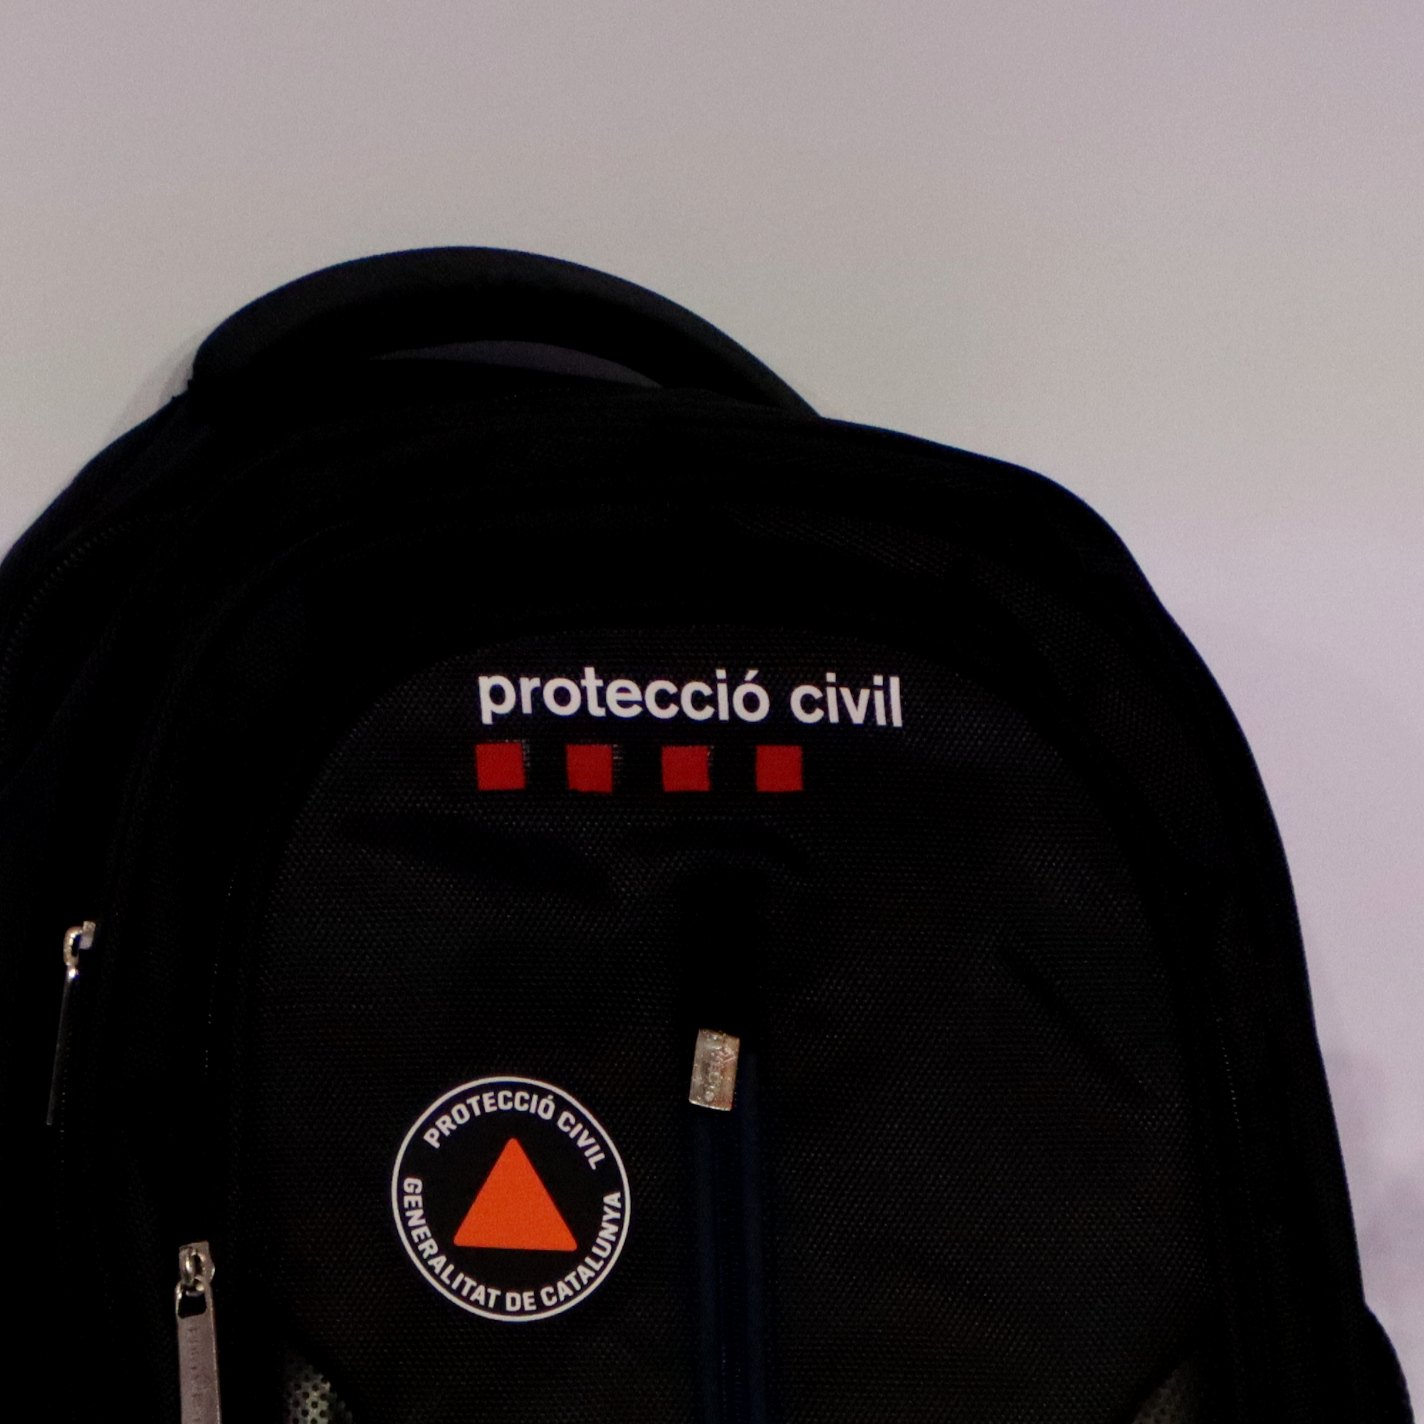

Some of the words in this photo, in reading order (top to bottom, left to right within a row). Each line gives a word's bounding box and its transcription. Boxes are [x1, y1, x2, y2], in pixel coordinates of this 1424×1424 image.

[478, 666, 770, 724] protecció
[790, 672, 904, 728] civil
[422, 1089, 556, 1149] PROTECCIÓ
[557, 1110, 607, 1171] CIVIL
[402, 1176, 502, 1310] GENERALITAT
[505, 1291, 537, 1312] DE
[539, 1191, 623, 1307] CATALUNYA
